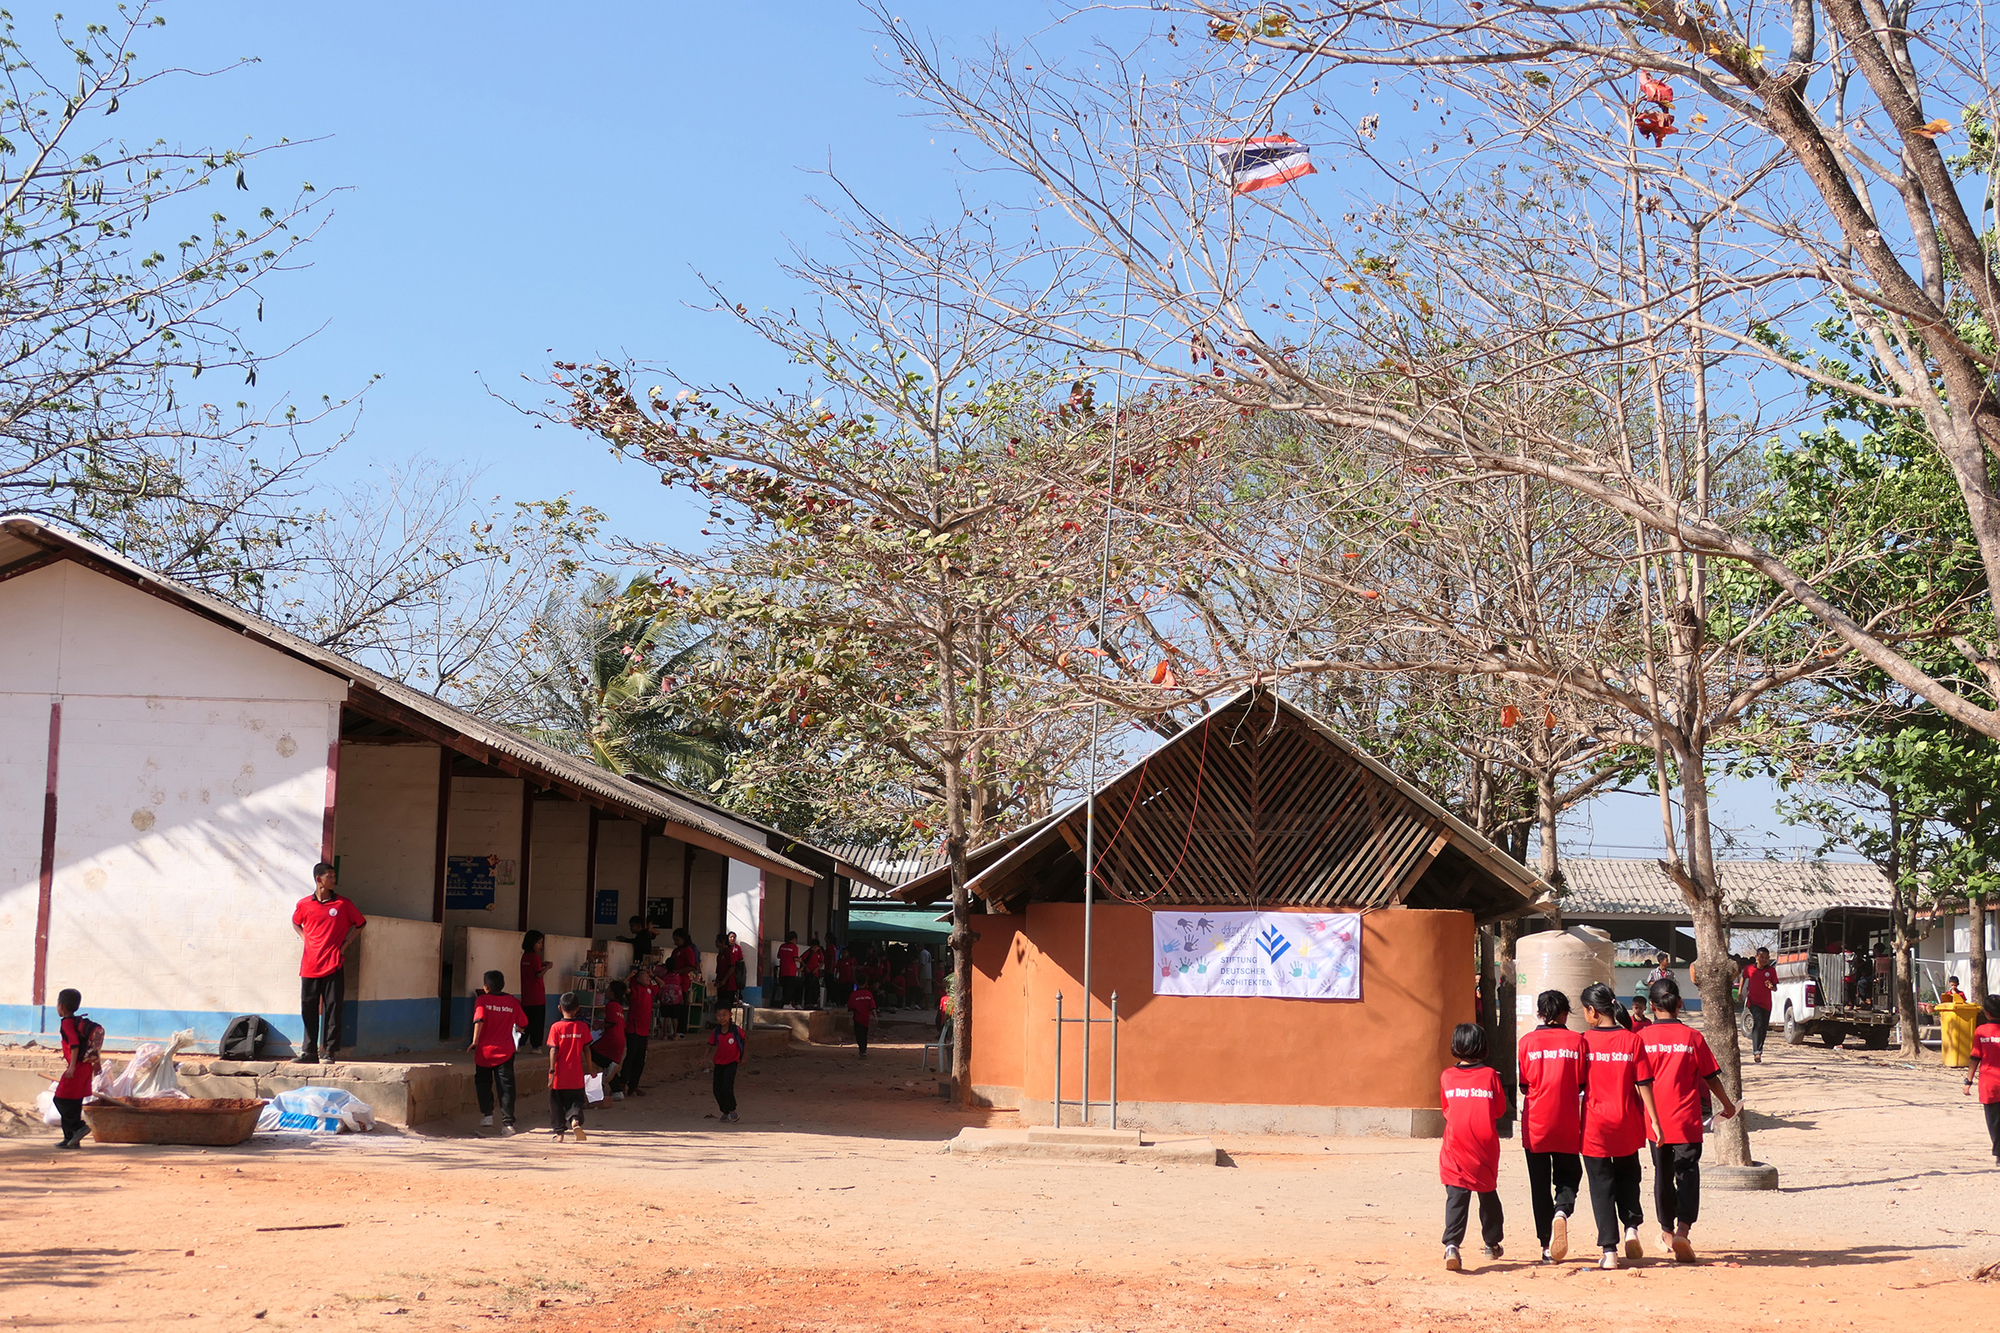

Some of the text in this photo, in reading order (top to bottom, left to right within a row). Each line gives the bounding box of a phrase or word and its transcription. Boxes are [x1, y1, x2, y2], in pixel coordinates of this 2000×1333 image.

[1220, 967, 1266, 975] DEUTSCHER
[1220, 978, 1272, 986] ARCHITEKTEN
[1658, 1043, 1672, 1053] Day
[1543, 1049, 1557, 1059] Day
[1586, 1052, 1595, 1061] ew
[1595, 1051, 1610, 1062] Day
[1455, 1087, 1469, 1098] Day
[1470, 1087, 1493, 1099] School
